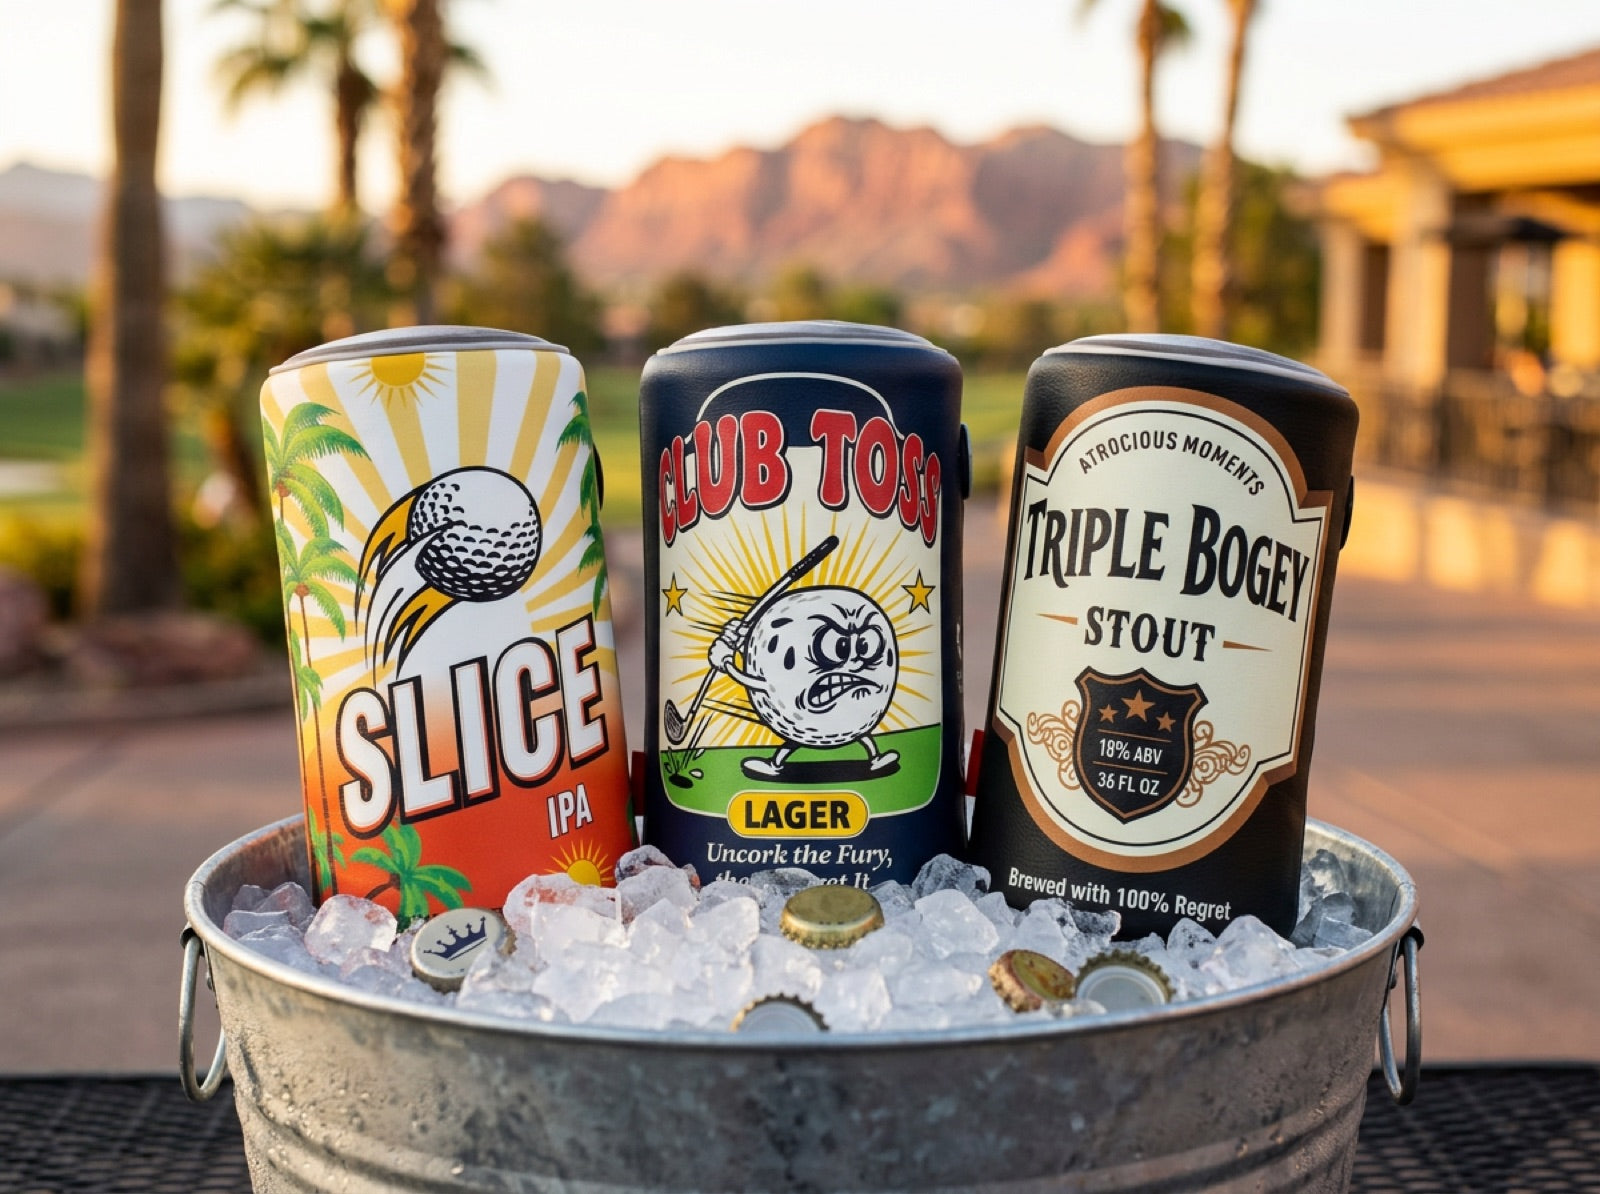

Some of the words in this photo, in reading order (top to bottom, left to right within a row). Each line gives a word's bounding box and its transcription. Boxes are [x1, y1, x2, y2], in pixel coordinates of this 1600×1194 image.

[659, 410, 793, 547] CLUB
[810, 408, 942, 547] TOSS
[1078, 430, 1178, 475] ATROCIOUS
[1182, 435, 1265, 497] MOMENTS
[1023, 498, 1170, 589] TRIPLE
[1180, 504, 1310, 623] BOGEY
[1084, 605, 1216, 662] STOUT
[336, 613, 609, 840] SLICE
[1099, 738, 1130, 760] 18%
[1133, 746, 1163, 765] ABV
[546, 783, 593, 840] IPA
[1097, 771, 1115, 789] 36
[1118, 774, 1136, 793] FL
[1139, 777, 1160, 796] OZ
[744, 800, 851, 829] LAGER
[707, 842, 788, 865] Uncork
[793, 844, 832, 865] the
[836, 844, 893, 871] Fury,
[1008, 867, 1067, 897] Brewed
[1071, 882, 1110, 905] with
[1117, 887, 1169, 914] 100%
[1174, 895, 1231, 922] Regret
